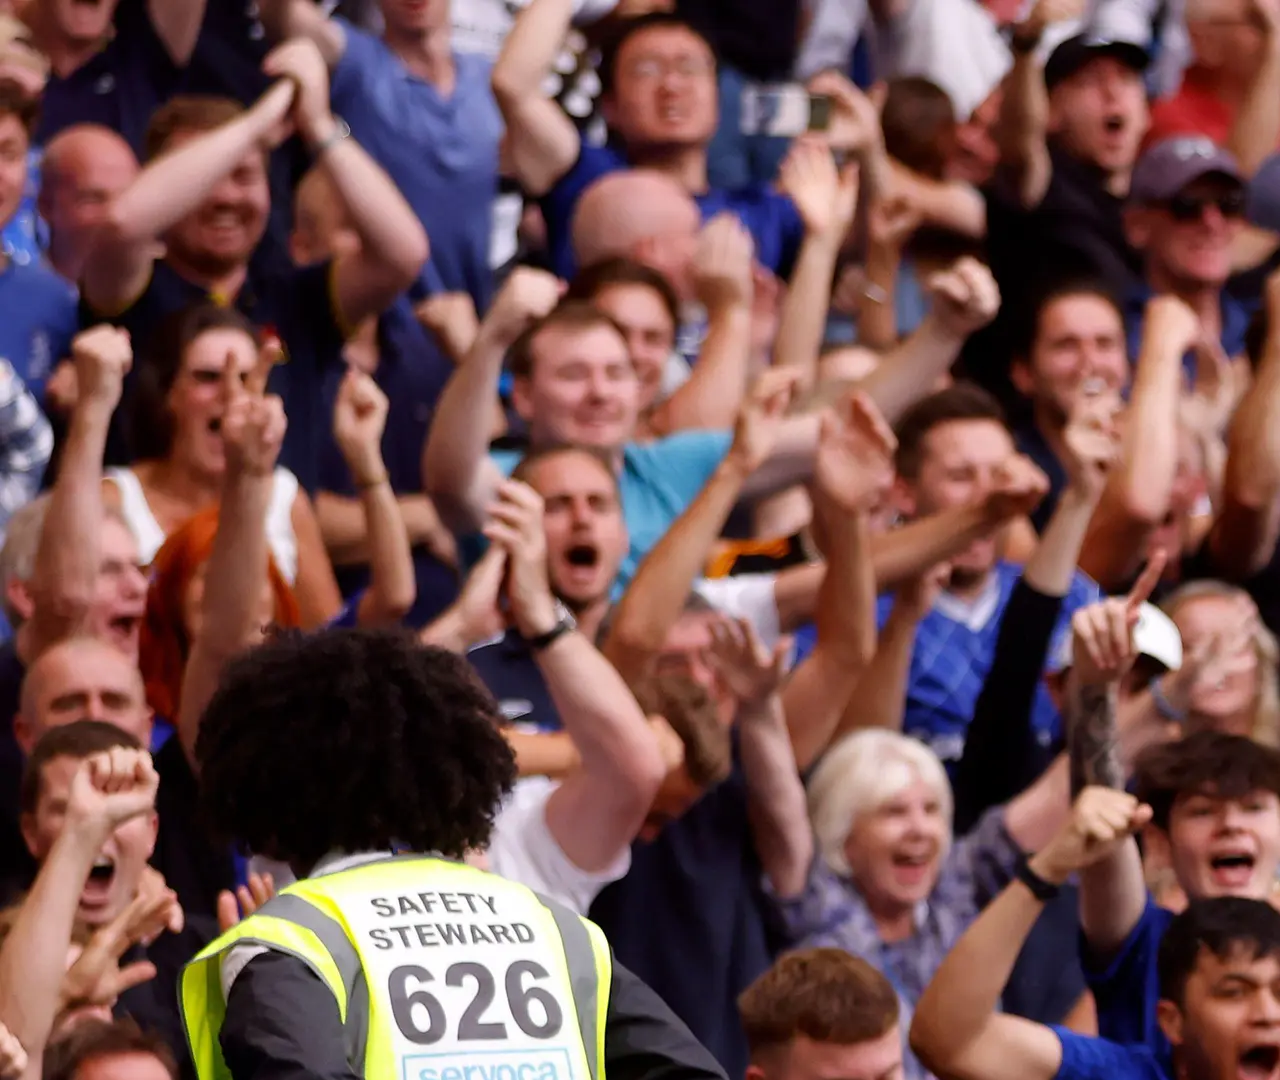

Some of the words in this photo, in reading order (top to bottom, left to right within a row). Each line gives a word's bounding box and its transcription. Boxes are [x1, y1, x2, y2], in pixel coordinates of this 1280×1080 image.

[371, 892, 498, 917] SAFETY
[369, 923, 535, 950] STEWARD
[388, 960, 562, 1045] 626
